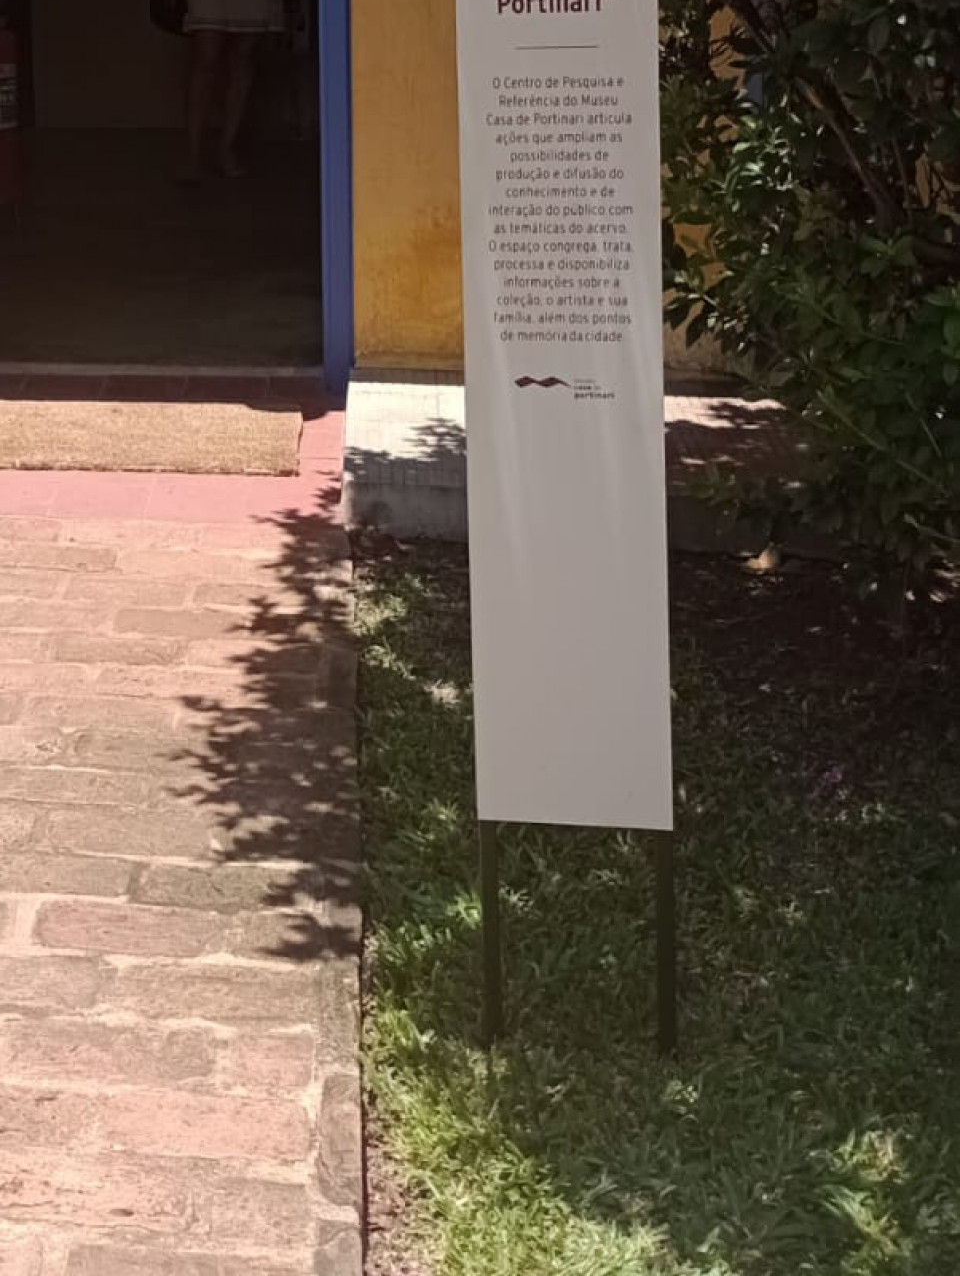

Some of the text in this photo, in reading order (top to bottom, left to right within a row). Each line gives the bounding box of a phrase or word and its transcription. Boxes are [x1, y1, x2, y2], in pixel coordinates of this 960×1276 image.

[492, 76, 624, 90] O Centro de Pesquisa e
[499, 93, 618, 107] Referência do Museu
[486, 112, 632, 126] Casa de Portinari articula
[496, 130, 623, 146] ações que ampliam as
[510, 150, 609, 162] possibilidades de
[496, 166, 624, 181] produção e difusão do
[505, 185, 615, 198] conhecimento e de
[488, 204, 634, 218] interação do público com
[494, 223, 506, 234] as
[510, 222, 566, 234] temáticas
[569, 222, 583, 233] do
[489, 240, 496, 252] O
[500, 241, 540, 254] espaço
[494, 259, 544, 270] processa
[547, 259, 554, 269] e
[504, 275, 619, 290] informações sobre a
[546, 296, 554, 306] o
[557, 294, 594, 306] artista
[598, 296, 604, 306] e
[609, 296, 628, 306] sua
[538, 311, 565, 323] além
[569, 313, 589, 324] dos
[592, 311, 631, 325] pontos
[500, 329, 513, 341] de
[518, 330, 567, 341] memória
[569, 330, 583, 341] da
